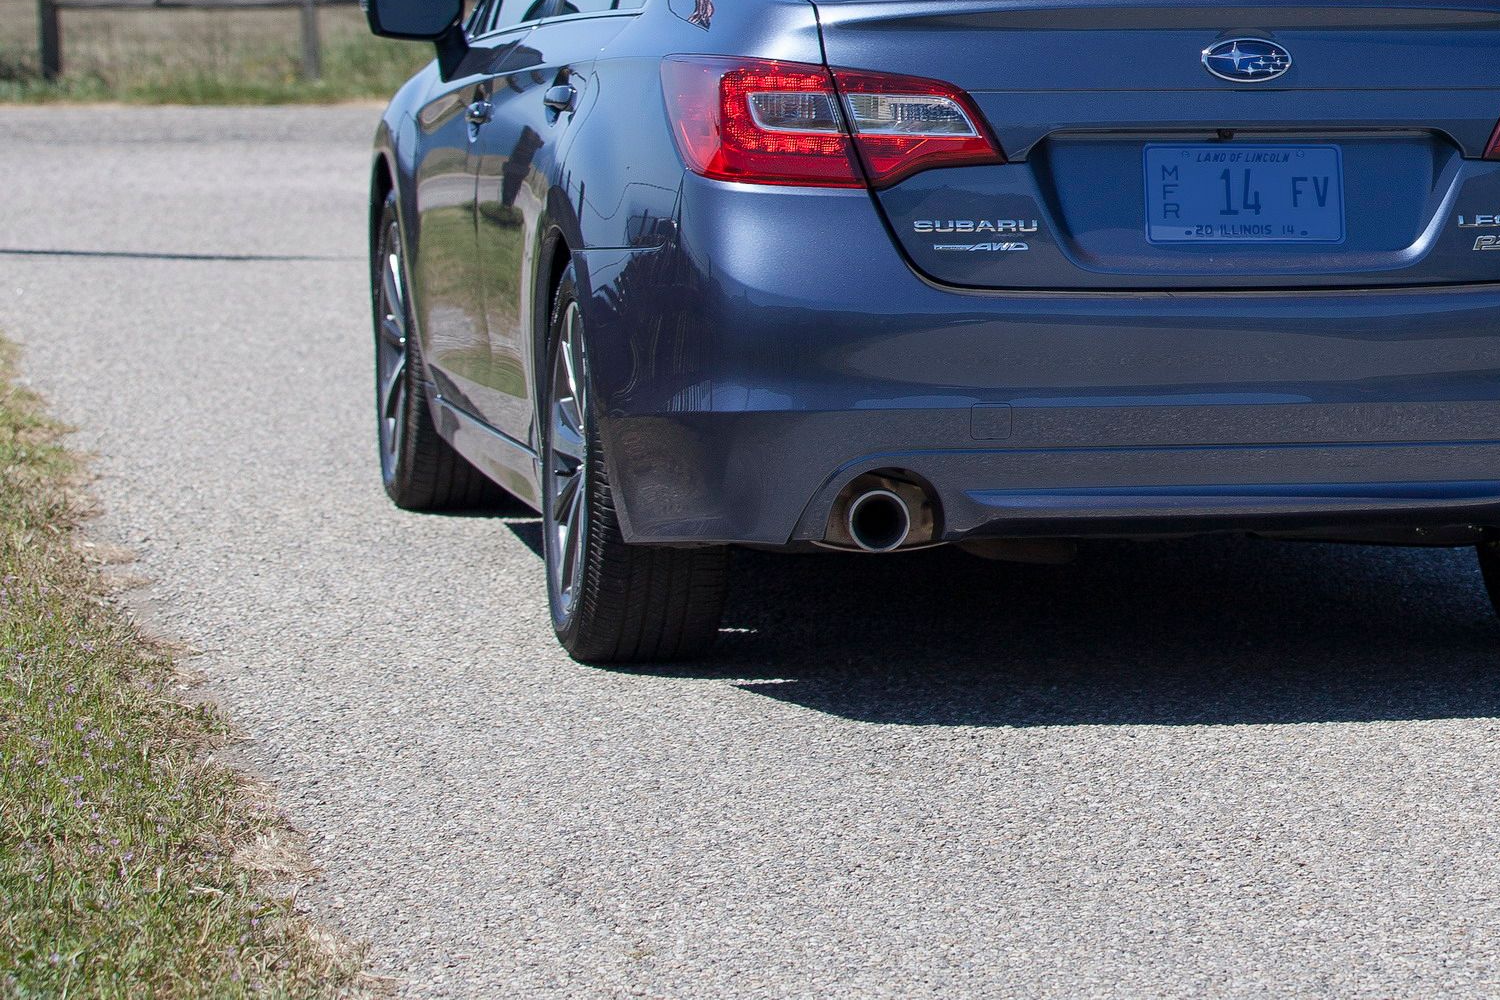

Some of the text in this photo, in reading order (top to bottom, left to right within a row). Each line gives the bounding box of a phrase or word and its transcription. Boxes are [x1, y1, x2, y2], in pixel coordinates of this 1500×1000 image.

[1196, 152, 1290, 163] LAND OF LINCOLN
[1219, 168, 1329, 216] 14 FV
[914, 219, 1038, 233] SUBARU
[1195, 224, 1294, 235] 20 ILLINOIS 14
[969, 242, 1029, 251] AWD
